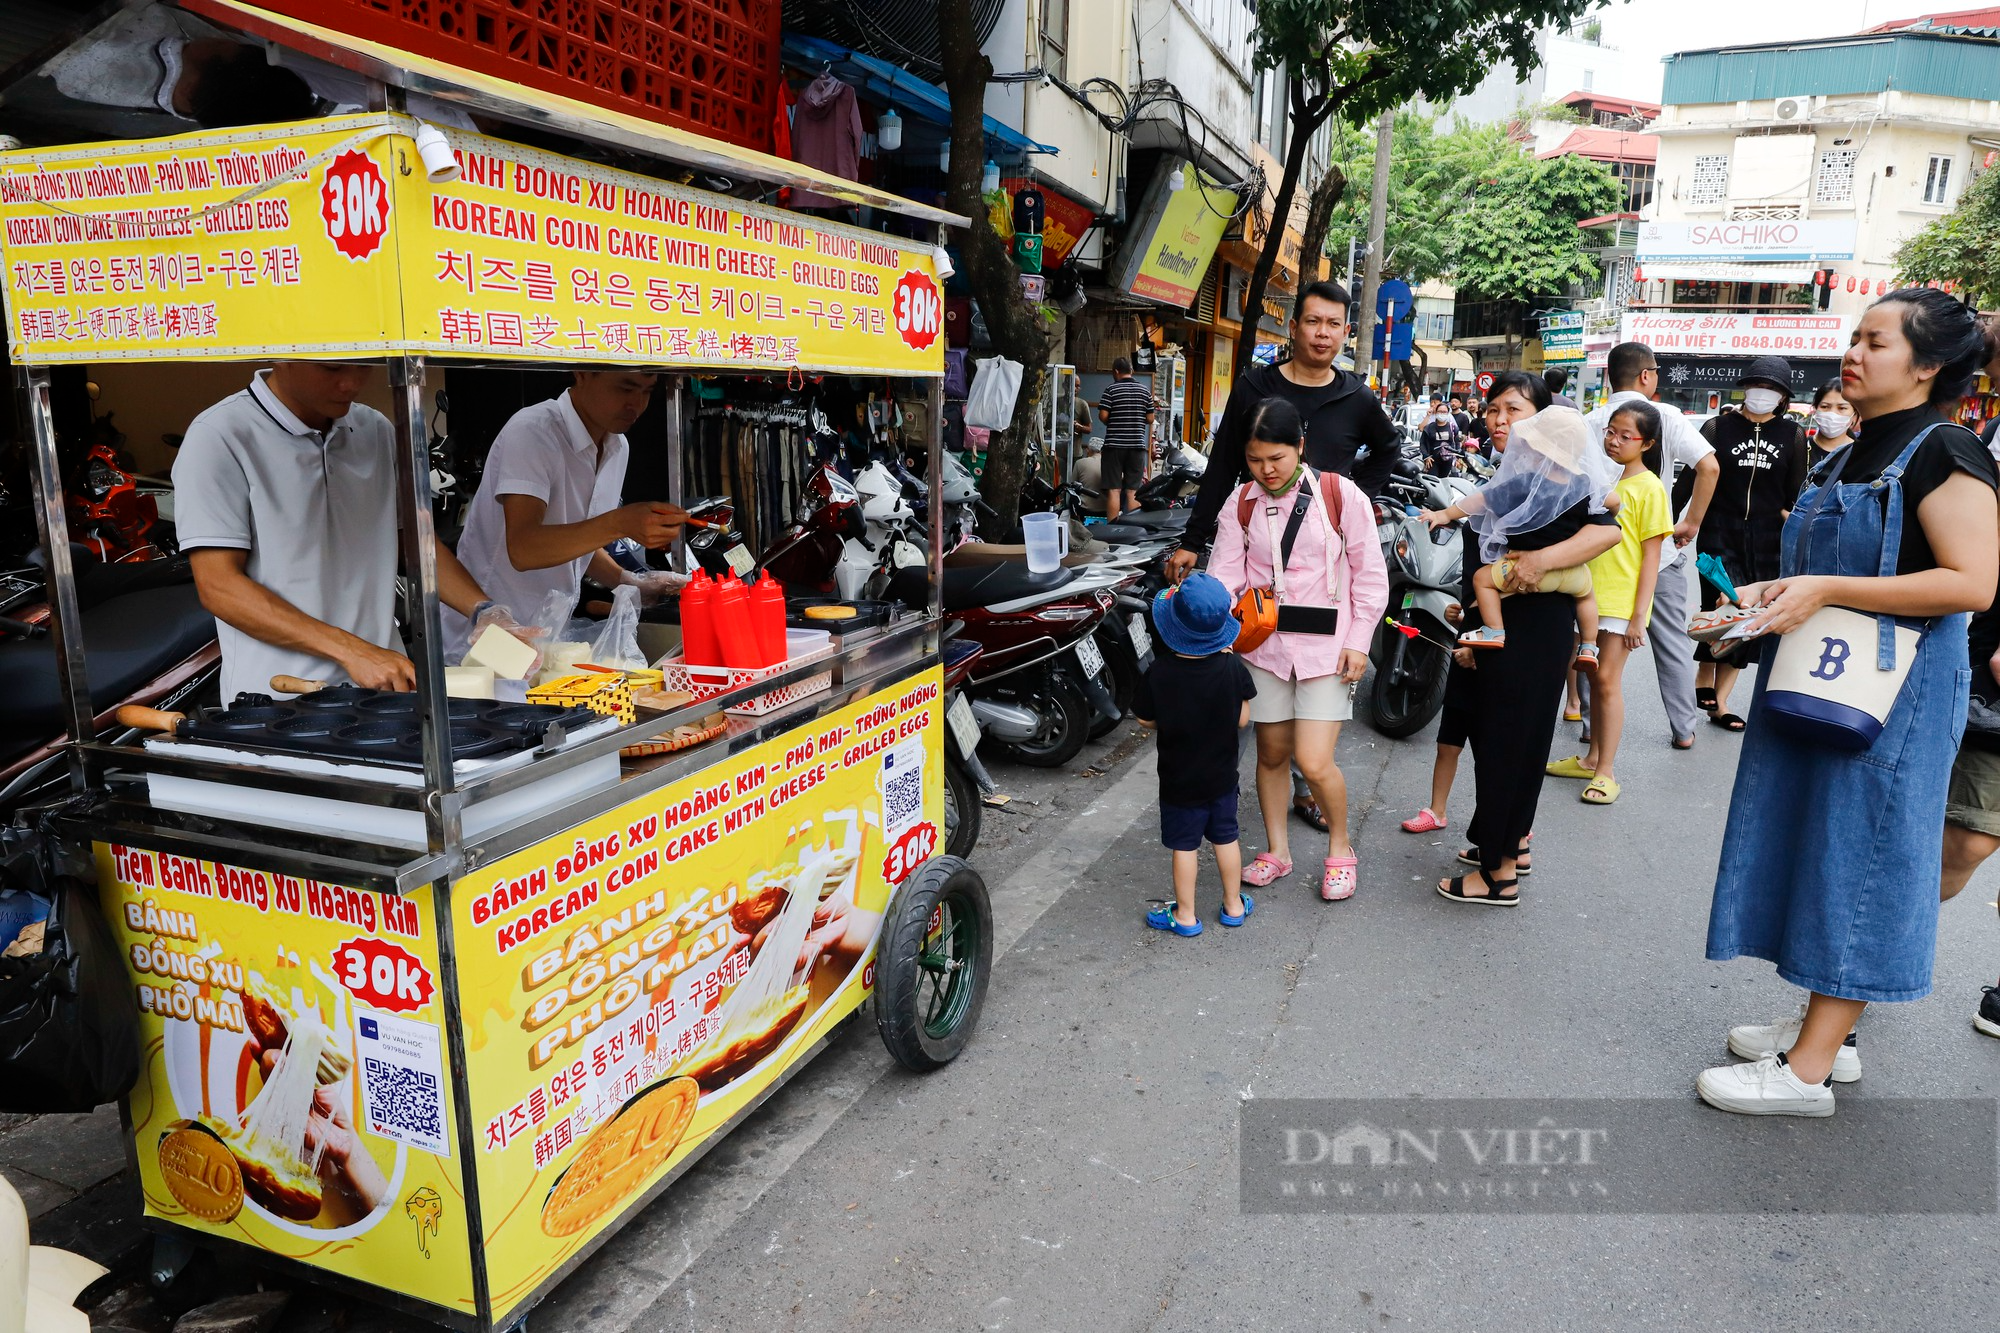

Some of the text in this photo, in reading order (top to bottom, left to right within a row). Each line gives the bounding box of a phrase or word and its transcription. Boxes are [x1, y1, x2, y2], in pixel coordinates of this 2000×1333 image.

[1, 171, 33, 203] BÁNH
[34, 164, 67, 201] ĐỒNG
[66, 171, 84, 199] XU
[84, 164, 126, 197] HOÀNG
[126, 165, 151, 194] KIM
[216, 151, 260, 186] TRỨNG
[262, 146, 309, 181] NƯỚNG
[6, 217, 52, 245] KOREAN
[54, 215, 82, 243] COIN
[84, 213, 114, 241] CAKE
[115, 211, 145, 239] WITH
[147, 207, 192, 237] CHEESE
[204, 202, 253, 233] GRILLED
[256, 199, 289, 229] EGGS
[329, 172, 383, 238] 30K
[588, 179, 616, 211] XU
[695, 206, 728, 234] KIM
[433, 195, 536, 242] KOREAN
[545, 216, 599, 252] COIN
[607, 228, 658, 261] CAKE
[664, 238, 710, 269] WITH
[716, 247, 777, 280] CHEESE
[792, 261, 846, 291] GRILLED
[850, 272, 879, 296] EGGS
[1691, 224, 1798, 245] SACHIKO
[14, 259, 66, 296] 치즈를
[110, 254, 144, 292] 동전
[149, 253, 202, 291] 케이크
[219, 251, 256, 287] 구운
[262, 246, 301, 285] 계란
[437, 249, 557, 300] 치즈를
[644, 278, 701, 316] 동전
[711, 287, 787, 322] 케이크
[806, 299, 846, 332] 구운
[852, 306, 886, 335] 계란
[1699, 268, 1754, 278] SACHIKO
[898, 284, 940, 335] 30K
[1698, 315, 1738, 330] Silk
[1756, 320, 1768, 328] 54
[1818, 320, 1837, 329] CAN
[1654, 332, 1680, 348] DÀI
[1684, 332, 1717, 350] VIỆT
[1731, 335, 1838, 350] 0848.049.124
[1695, 367, 1742, 377] MOCHI
[1731, 439, 1780, 459] CHANEL
[1738, 459, 1772, 470] CAMBON
[1809, 636, 1852, 682] B
[472, 872, 547, 926] BÁNH
[555, 838, 621, 882] ĐỒNG
[627, 815, 658, 850] XU
[665, 782, 732, 830] HOÀNG
[736, 765, 766, 796] KIM
[785, 736, 815, 771] PHÔ
[854, 704, 897, 736] TRỨNG
[899, 683, 938, 714] NƯỚNG
[497, 882, 598, 954] KOREAN
[606, 857, 659, 898] COIN
[666, 826, 720, 862] CAKE
[724, 803, 766, 837] WITH
[769, 768, 827, 809] CHEESE
[842, 730, 899, 773] GRILLED
[900, 711, 931, 741] EGGS
[887, 828, 934, 881] 30K
[127, 899, 198, 939] BÁNH
[272, 872, 300, 913] Xu
[381, 892, 419, 937] Kim
[132, 936, 244, 991] ĐỒNG XU
[527, 888, 739, 1024] ĐỒNG XU
[528, 889, 667, 989] BÁNH
[344, 947, 423, 1002] 30K
[536, 924, 729, 1064] PHÔ MAI
[140, 984, 244, 1031] PHÔ MAI
[486, 1087, 547, 1151] 치즈를
[592, 1033, 626, 1077] 동전
[628, 999, 677, 1050] 케이크
[687, 970, 719, 1009] 구운
[720, 948, 750, 988] 계란
